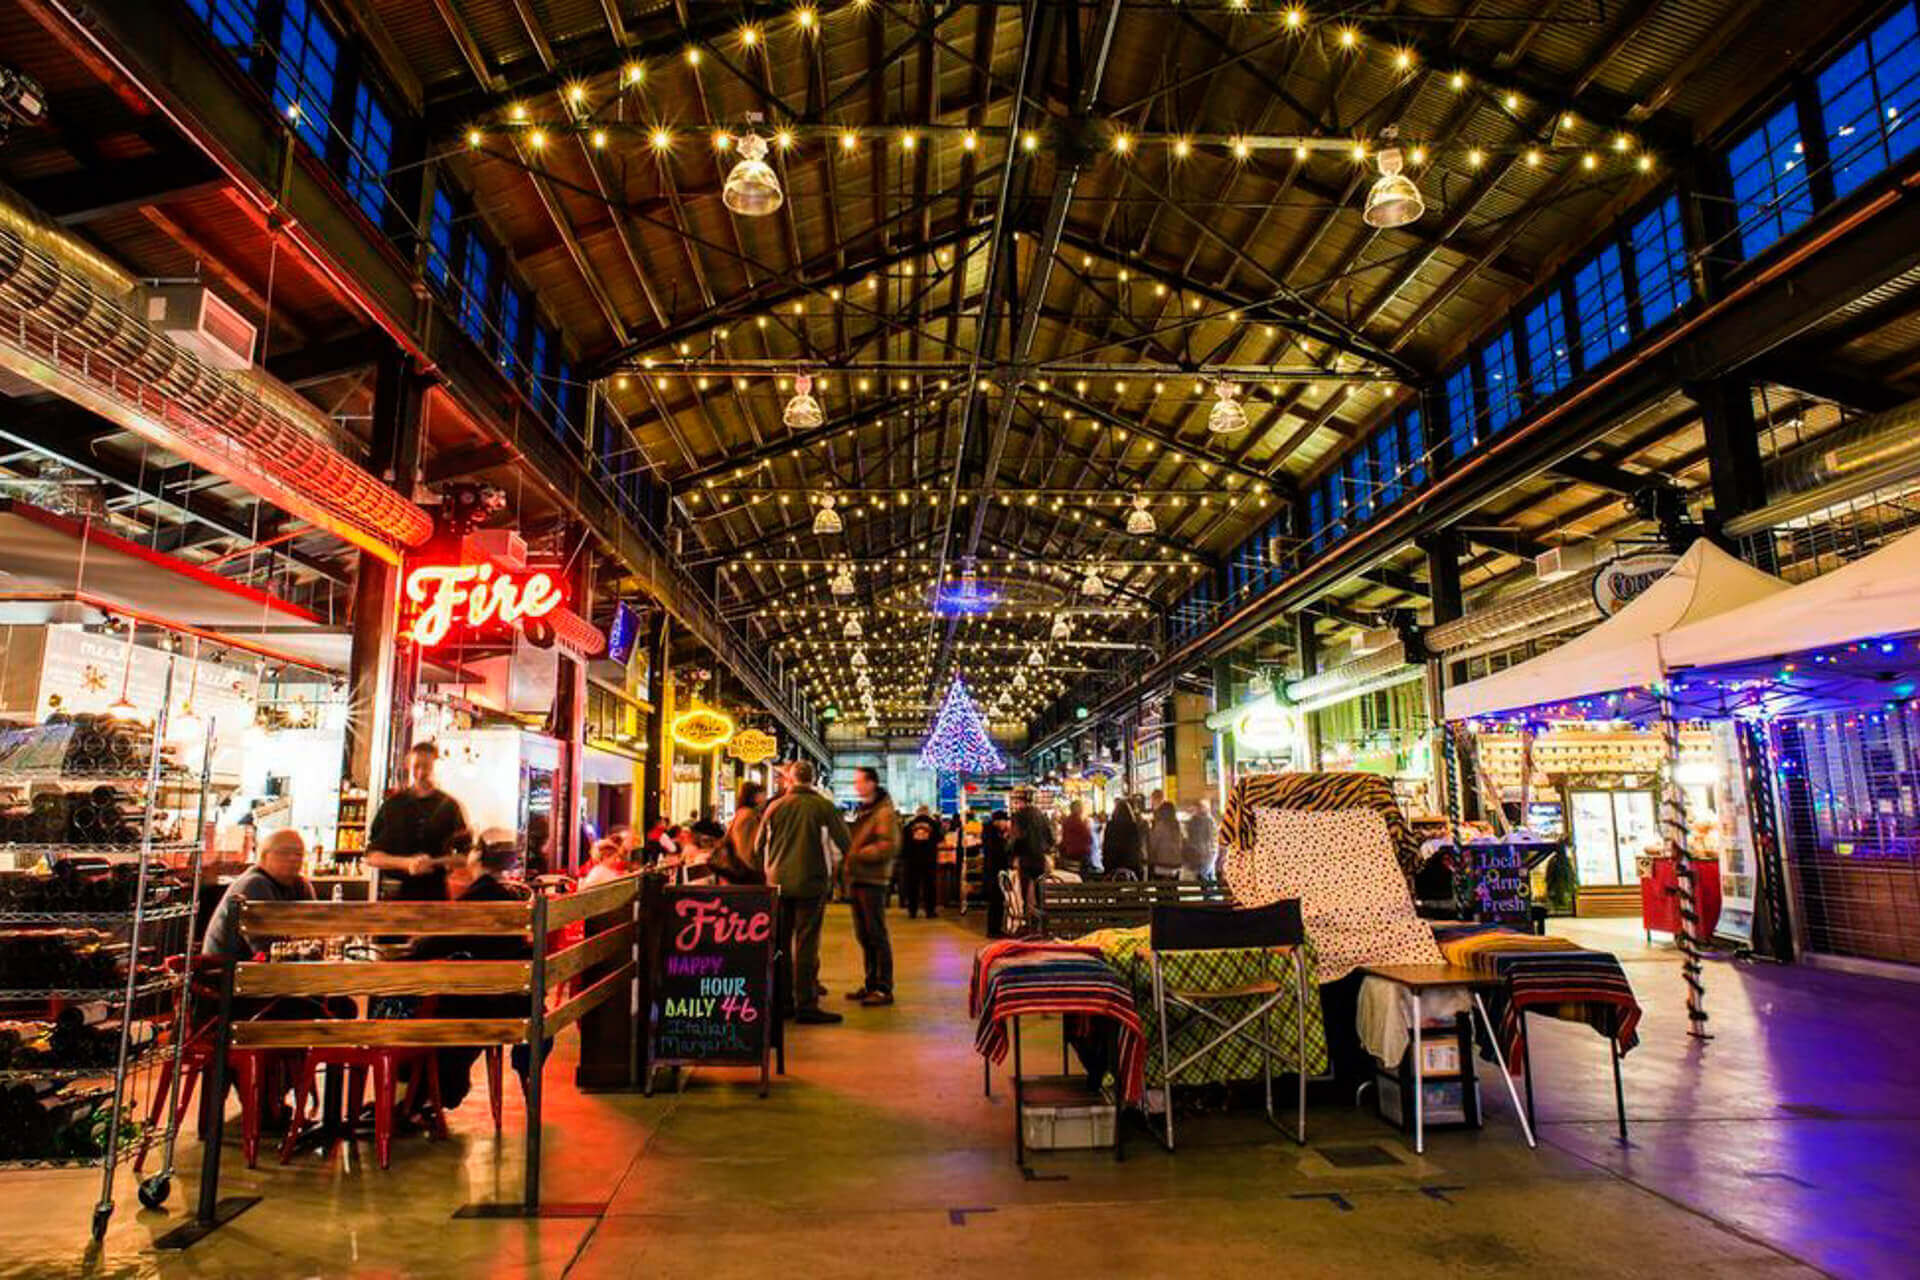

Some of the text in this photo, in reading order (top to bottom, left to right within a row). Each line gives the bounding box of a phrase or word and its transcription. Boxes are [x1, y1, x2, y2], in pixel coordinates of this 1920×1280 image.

[407, 562, 562, 646] Fire
[1480, 848, 1522, 869] Local
[1482, 894, 1525, 912] Fresh
[675, 896, 771, 952] Fire
[666, 955, 724, 976] HAPPY
[700, 977, 747, 997] HOUR
[665, 997, 717, 1018] DAILY
